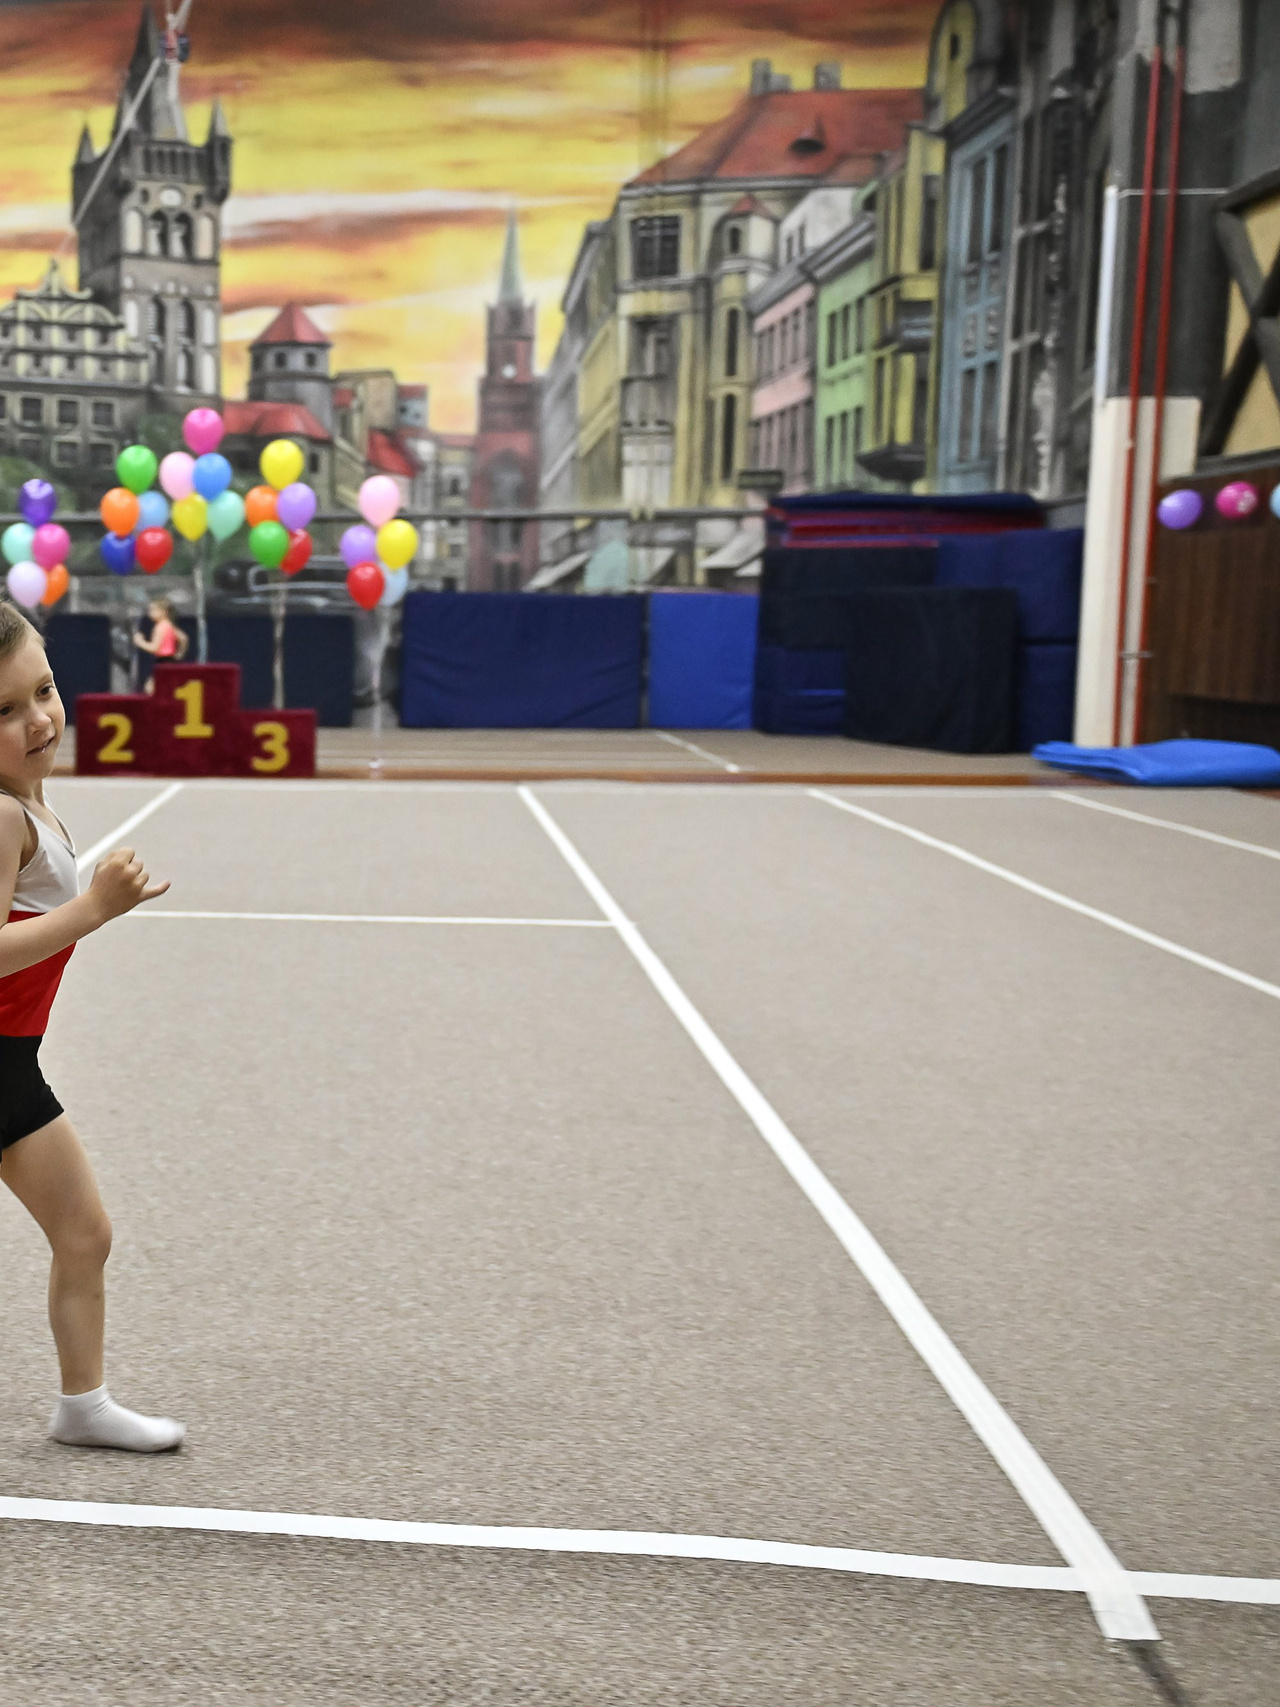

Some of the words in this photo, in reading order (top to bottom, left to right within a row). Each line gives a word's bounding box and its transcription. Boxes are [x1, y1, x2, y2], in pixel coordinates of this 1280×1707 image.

[174, 679, 214, 739] 1
[97, 713, 135, 763] 2
[251, 721, 290, 773] 3
